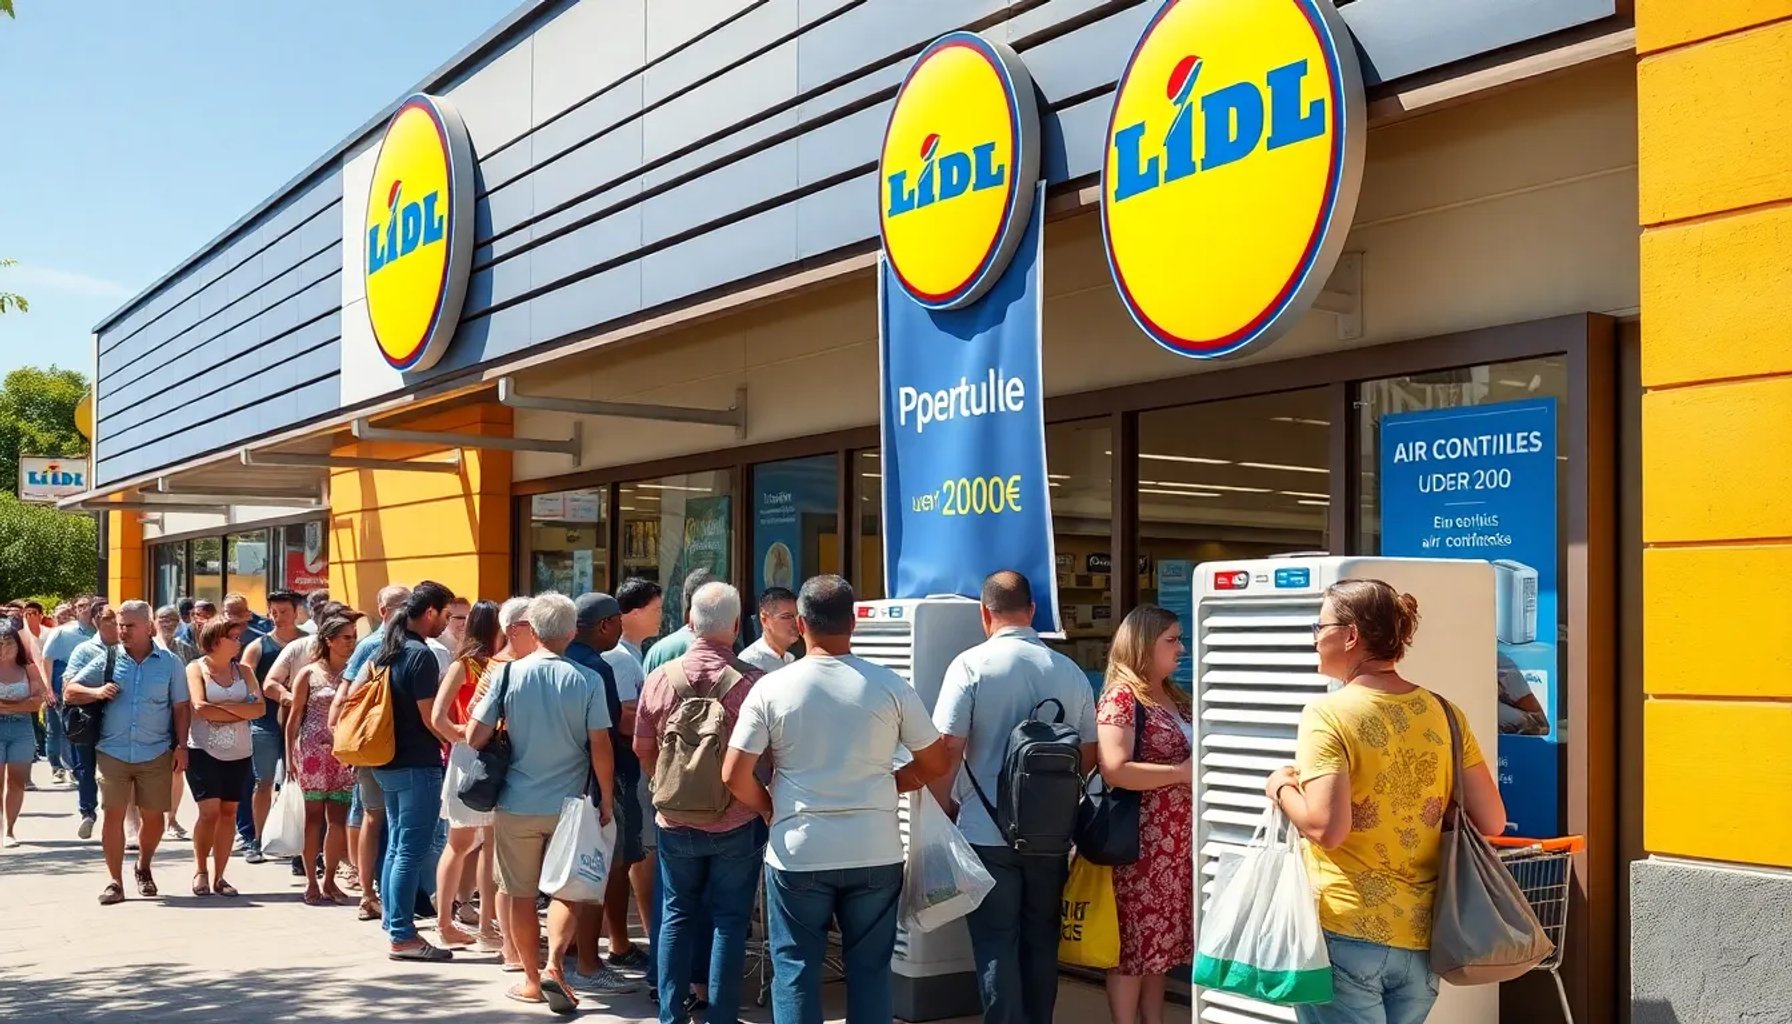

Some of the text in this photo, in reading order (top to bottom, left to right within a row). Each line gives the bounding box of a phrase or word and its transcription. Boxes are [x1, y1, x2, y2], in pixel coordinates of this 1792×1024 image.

[1393, 441, 1427, 463] AIR
[1418, 468, 1512, 493] UDER 200
[942, 474, 1022, 516] 2000€
